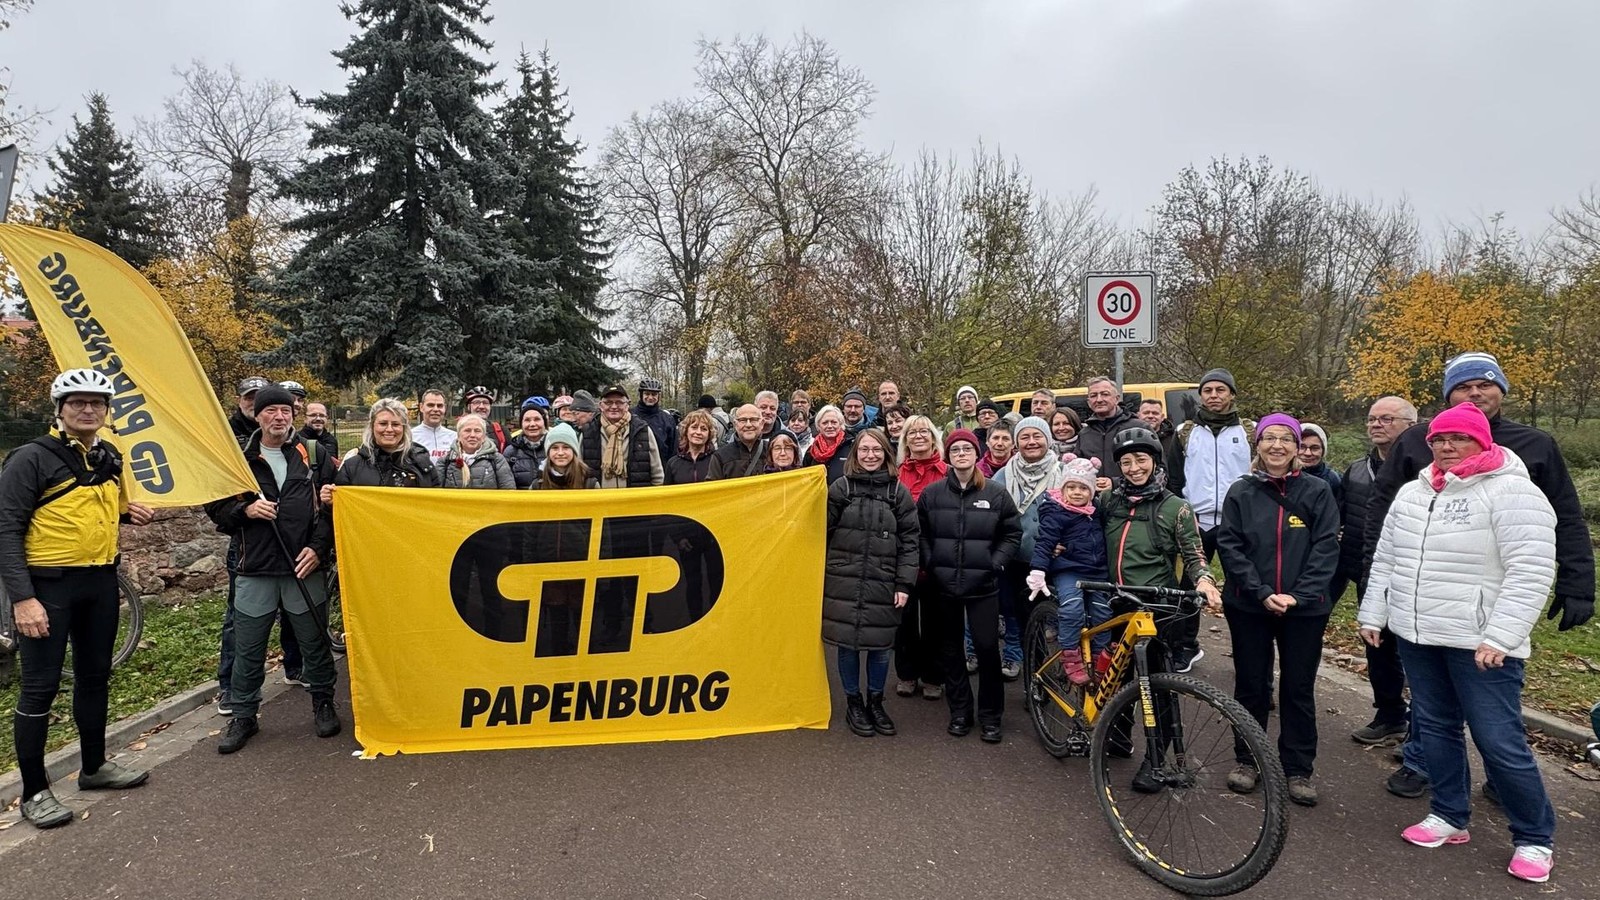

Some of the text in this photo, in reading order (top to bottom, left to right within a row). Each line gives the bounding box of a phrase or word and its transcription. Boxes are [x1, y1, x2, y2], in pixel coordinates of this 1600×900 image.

[1107, 293, 1132, 313] 30
[1103, 328, 1136, 339] ZONE
[460, 670, 731, 728] PAPENBURG
